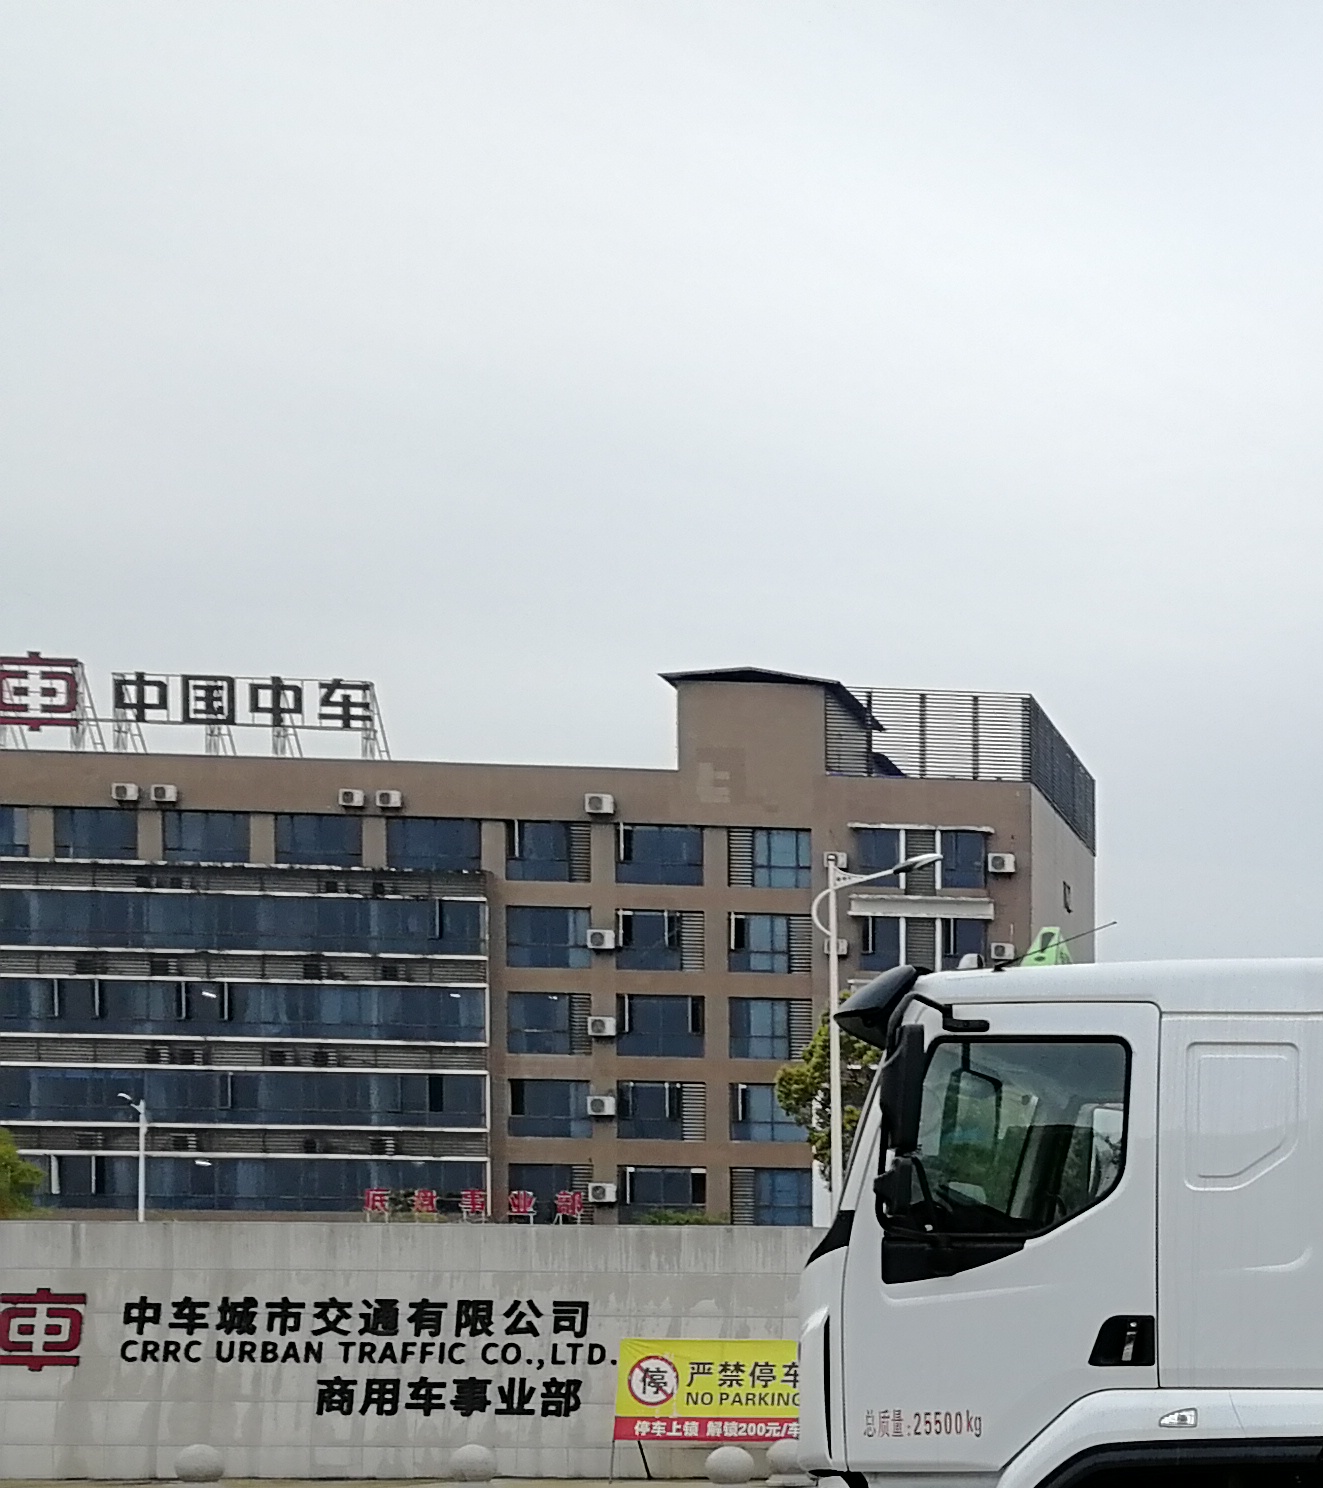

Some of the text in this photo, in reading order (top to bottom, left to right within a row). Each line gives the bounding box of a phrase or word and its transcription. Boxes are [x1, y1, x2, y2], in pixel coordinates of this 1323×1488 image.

[114, 672, 372, 728] 中国中车
[122, 1296, 590, 1338] 中车城市交通有限公司
[120, 1340, 202, 1364] CRRC
[215, 1340, 324, 1365] URBAN
[338, 1341, 466, 1366] TRAFFIC
[686, 1361, 799, 1388] 严禁停车
[315, 1377, 582, 1418] 商用车事业部
[686, 1392, 713, 1406] NO
[634, 1420, 699, 1437] 停车上锁
